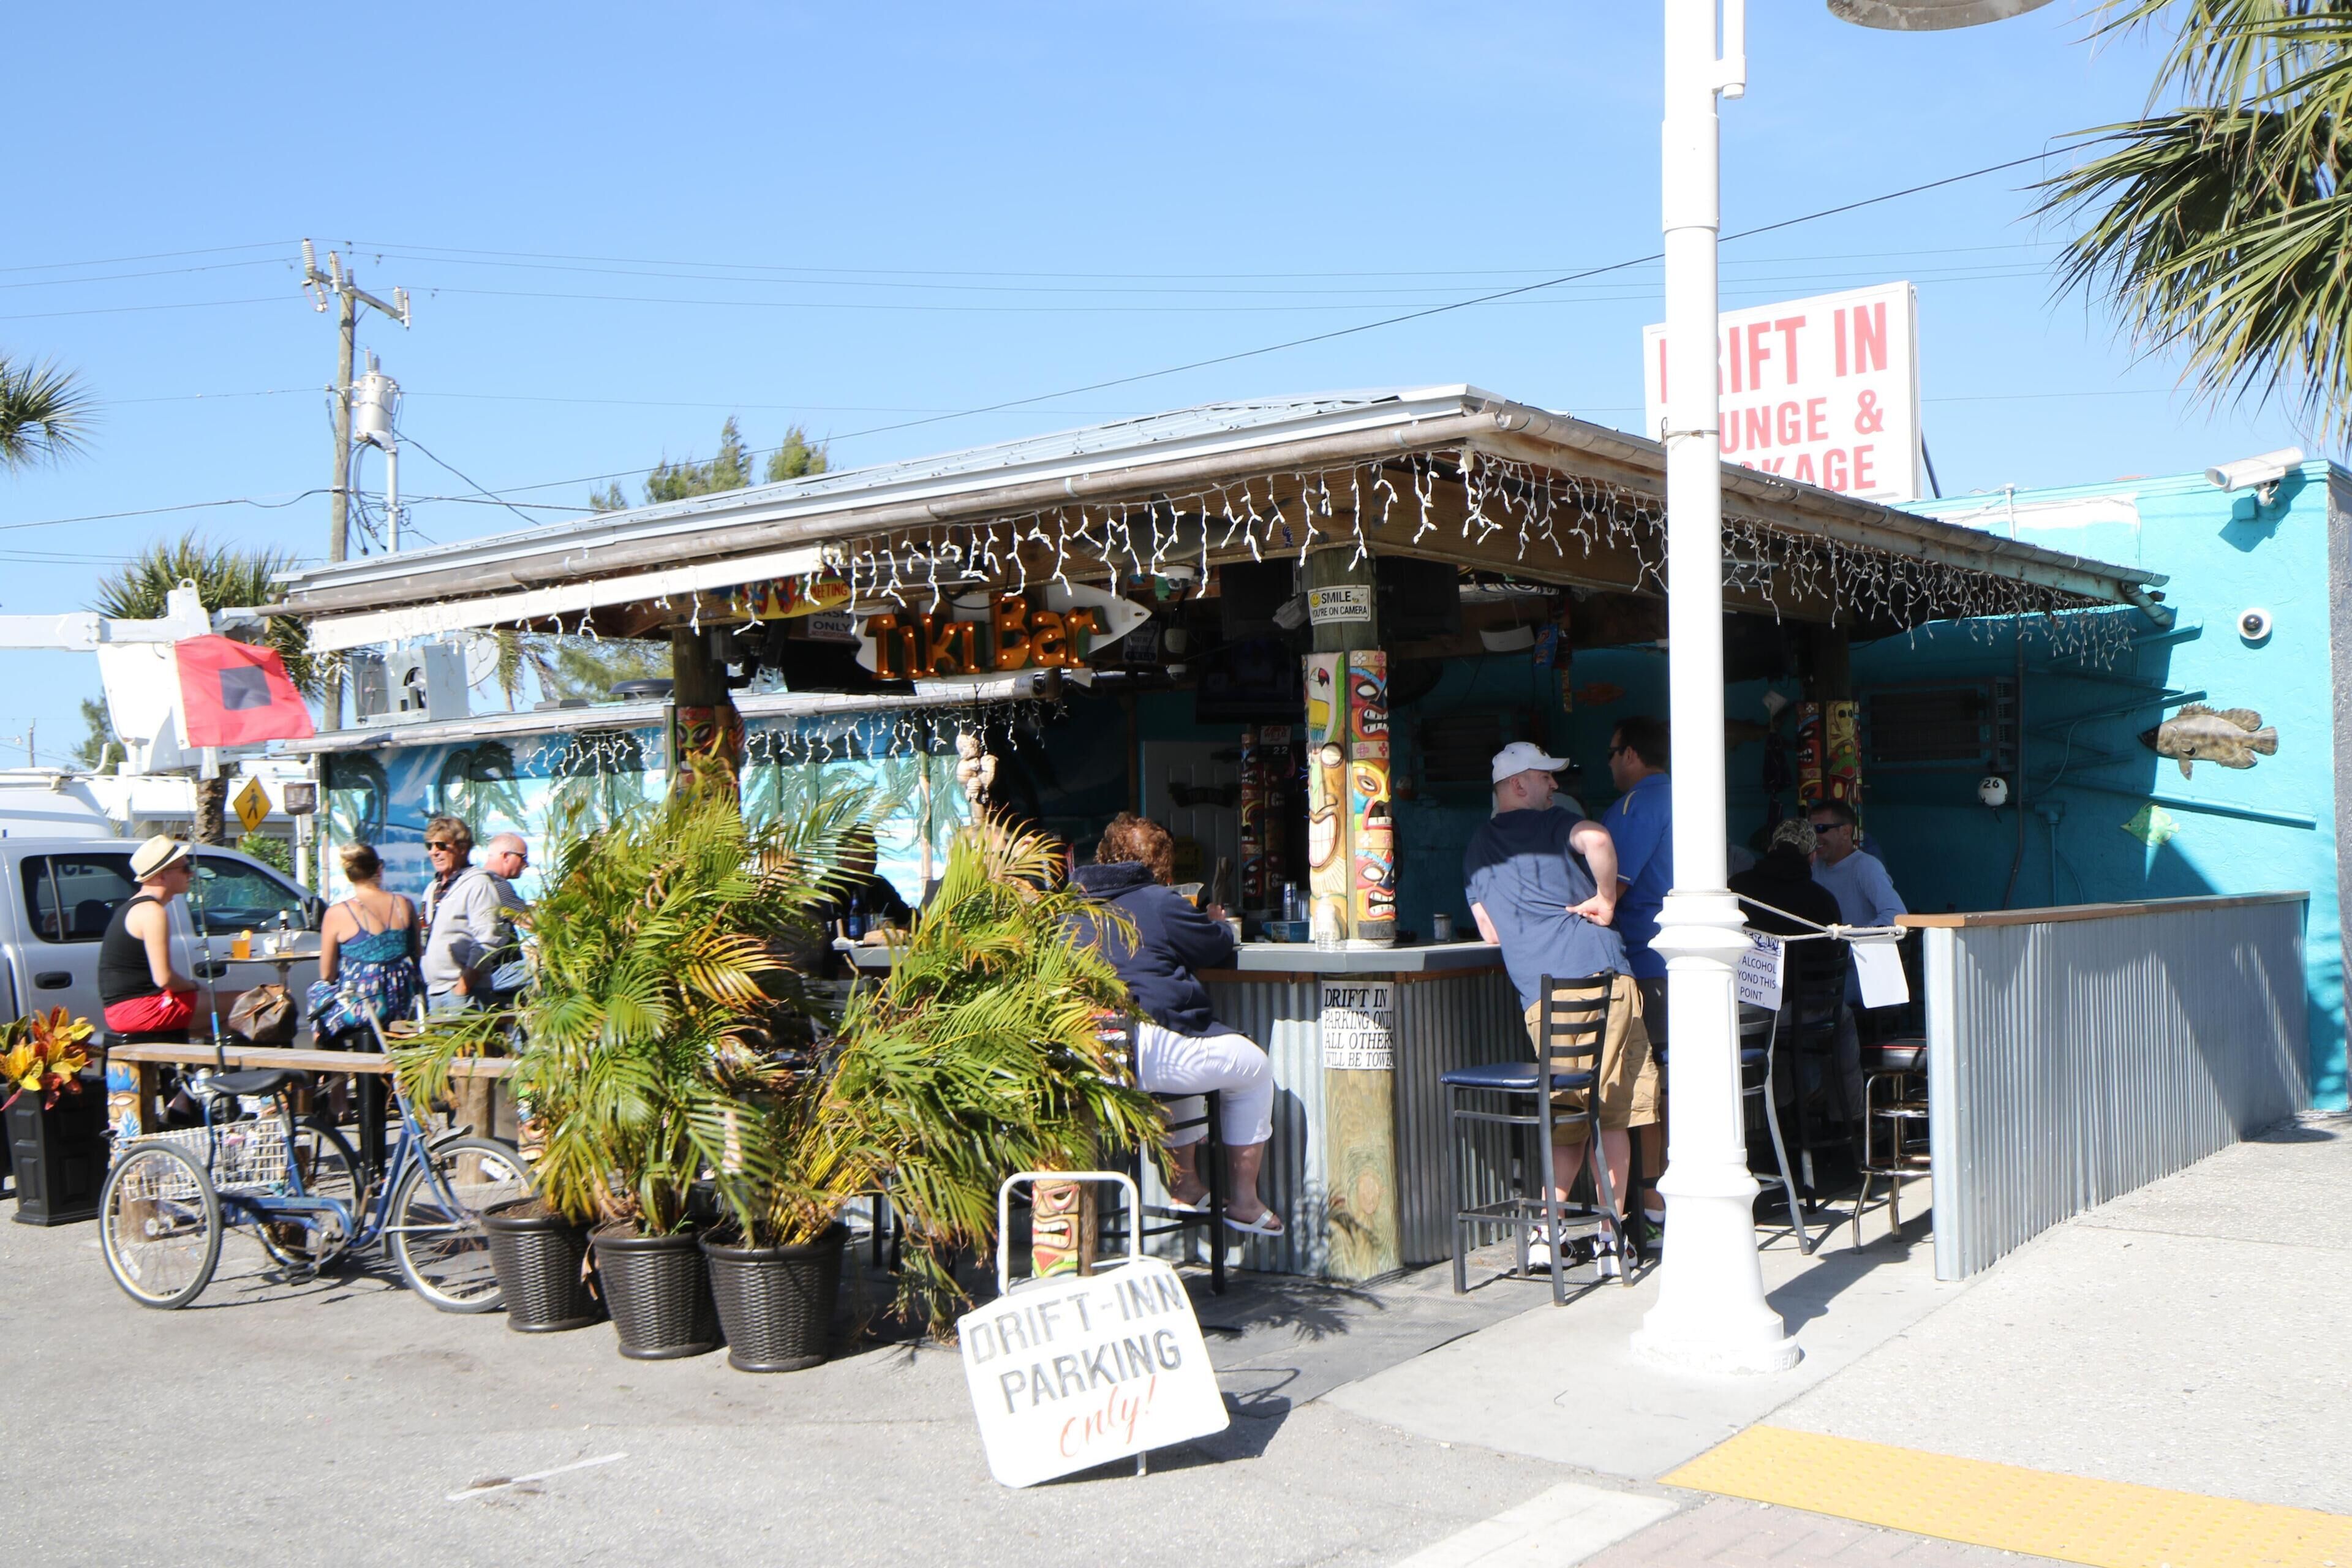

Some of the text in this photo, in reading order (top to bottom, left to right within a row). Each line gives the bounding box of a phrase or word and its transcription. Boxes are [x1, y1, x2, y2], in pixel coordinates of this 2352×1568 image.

[1660, 302, 1888, 404] IFT IN
[1854, 389, 1884, 435] &
[1321, 591, 1351, 604] SMILE
[813, 611, 851, 619] ASH
[1329, 606, 1339, 616] ON
[1340, 605, 1367, 615] CAMERA
[813, 620, 851, 632] ONLY
[1983, 778, 2000, 789] 26
[1742, 956, 1777, 974] ALCOHOL
[1759, 976, 1776, 990] THIS
[1324, 988, 1388, 1008] DRIFT IN
[1740, 986, 1763, 1001] POINT
[1324, 1010, 1370, 1030] PARKING
[1325, 1032, 1393, 1050] ALL OTHERS
[1325, 1051, 1345, 1067] WILL
[1348, 1052, 1362, 1067] BE
[969, 1273, 1185, 1365] DRIFT-INN
[998, 1328, 1182, 1414] PARKING
